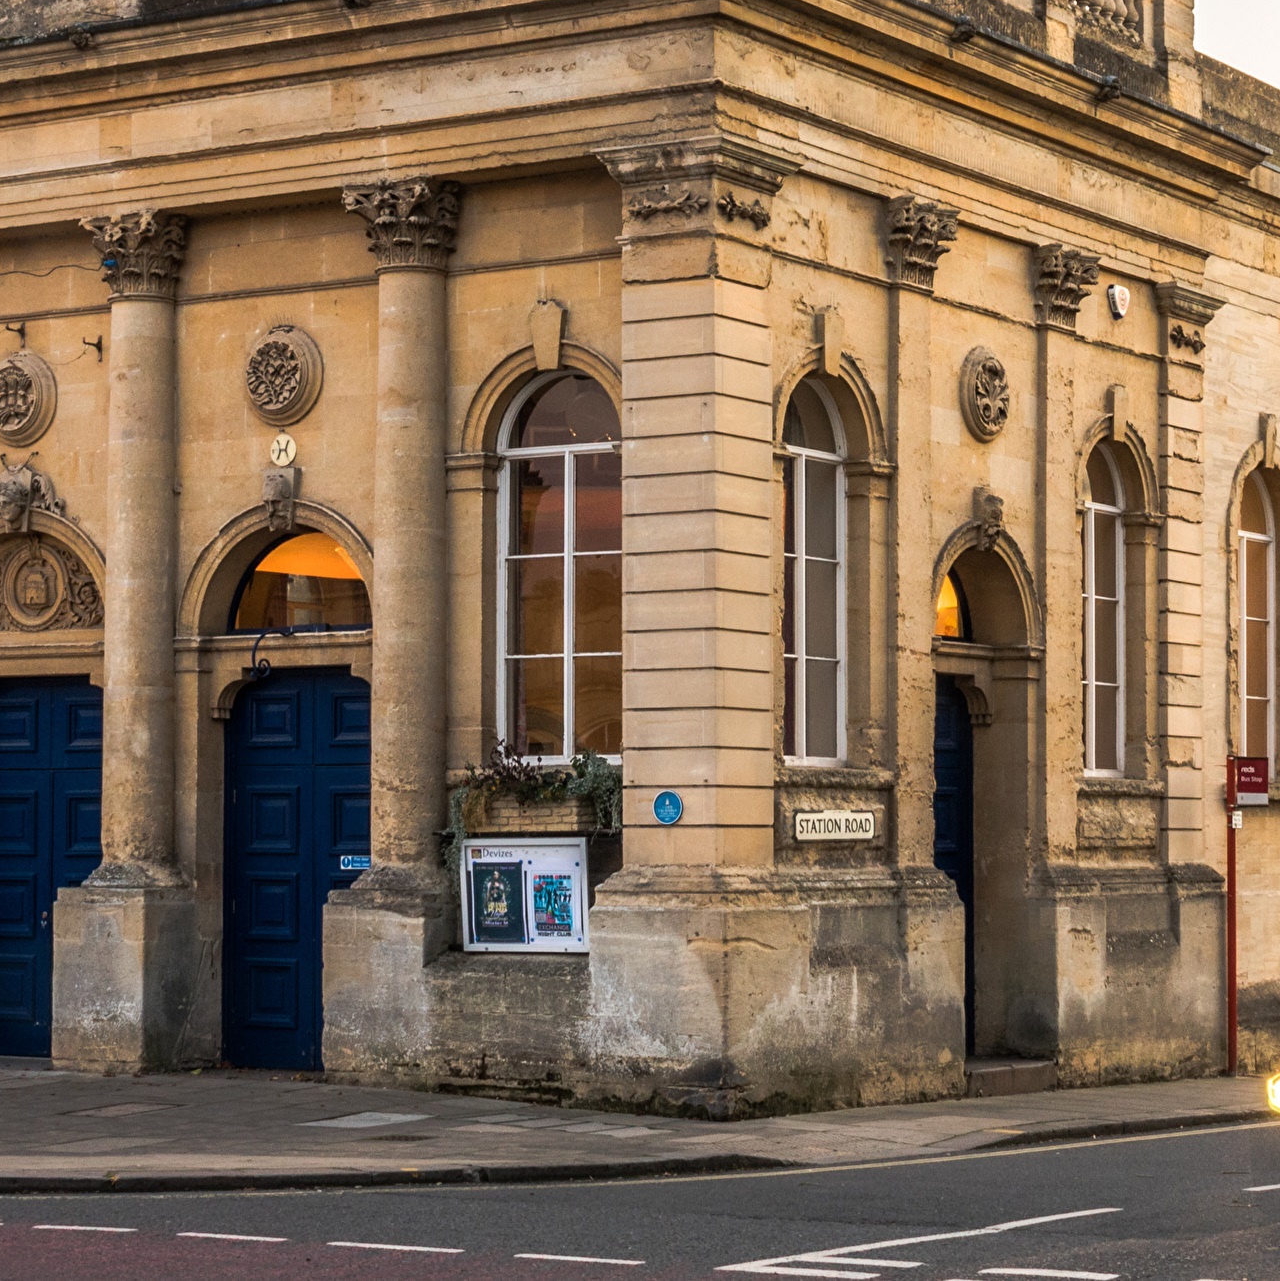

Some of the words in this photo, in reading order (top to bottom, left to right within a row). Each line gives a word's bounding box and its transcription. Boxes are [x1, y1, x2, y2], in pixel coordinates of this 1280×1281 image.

[799, 817, 842, 835] STATION
[844, 817, 872, 834] ROAD
[482, 847, 513, 858] Devizes
